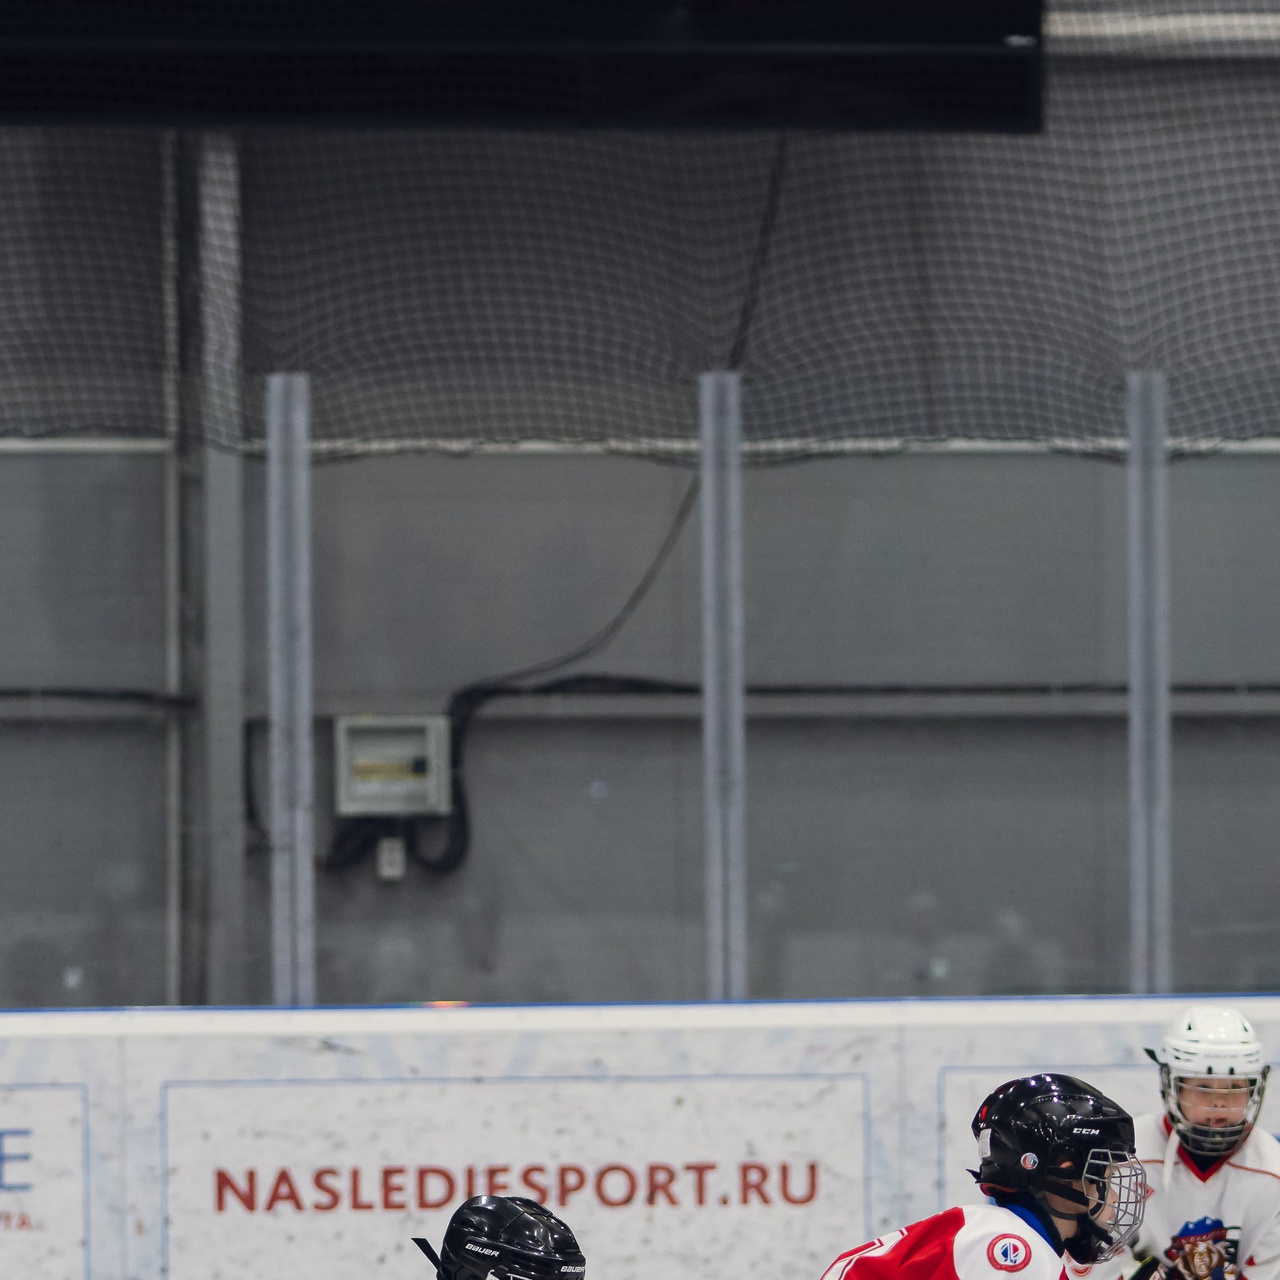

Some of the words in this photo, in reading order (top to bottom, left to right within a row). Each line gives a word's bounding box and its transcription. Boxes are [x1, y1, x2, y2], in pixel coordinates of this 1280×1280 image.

[1072, 1127, 1100, 1135] CCM
[214, 1161, 820, 1212] NASLEDIESPORT.RU
[465, 1243, 500, 1258] BAUER
[560, 1265, 585, 1273] BAUER
